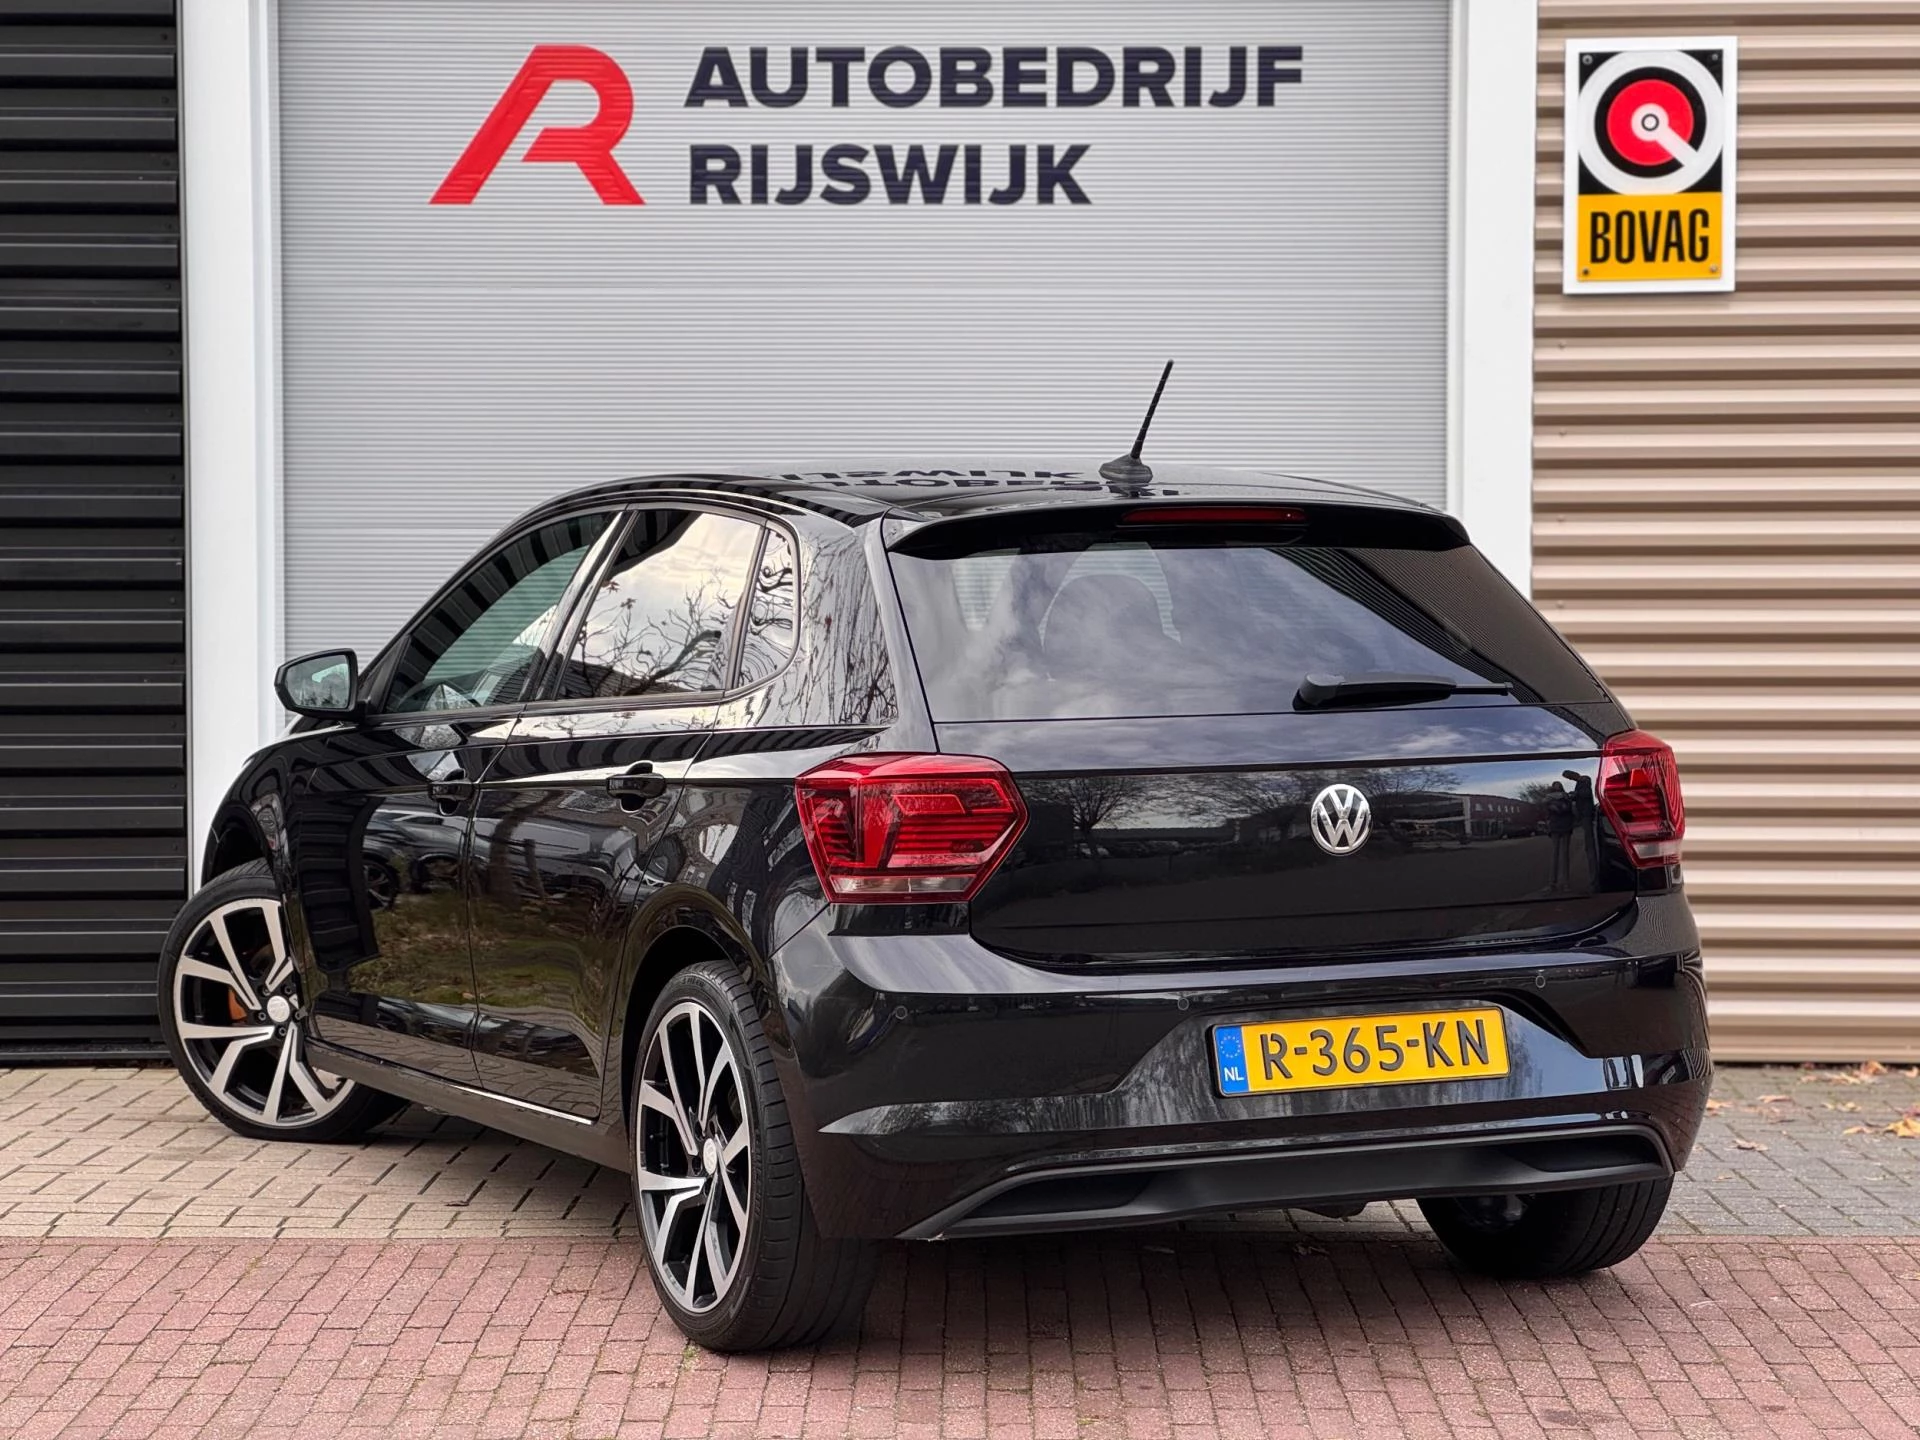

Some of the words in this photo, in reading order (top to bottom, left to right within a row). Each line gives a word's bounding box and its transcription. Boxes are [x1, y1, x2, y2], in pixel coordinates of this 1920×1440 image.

[684, 46, 1303, 108] AUTOBEDRIJF
[689, 144, 1092, 206] RIJSWIJK
[1590, 208, 1709, 264] BOVAG
[1224, 1066, 1245, 1082] NL
[1259, 1019, 1489, 1081] R-365-KN
